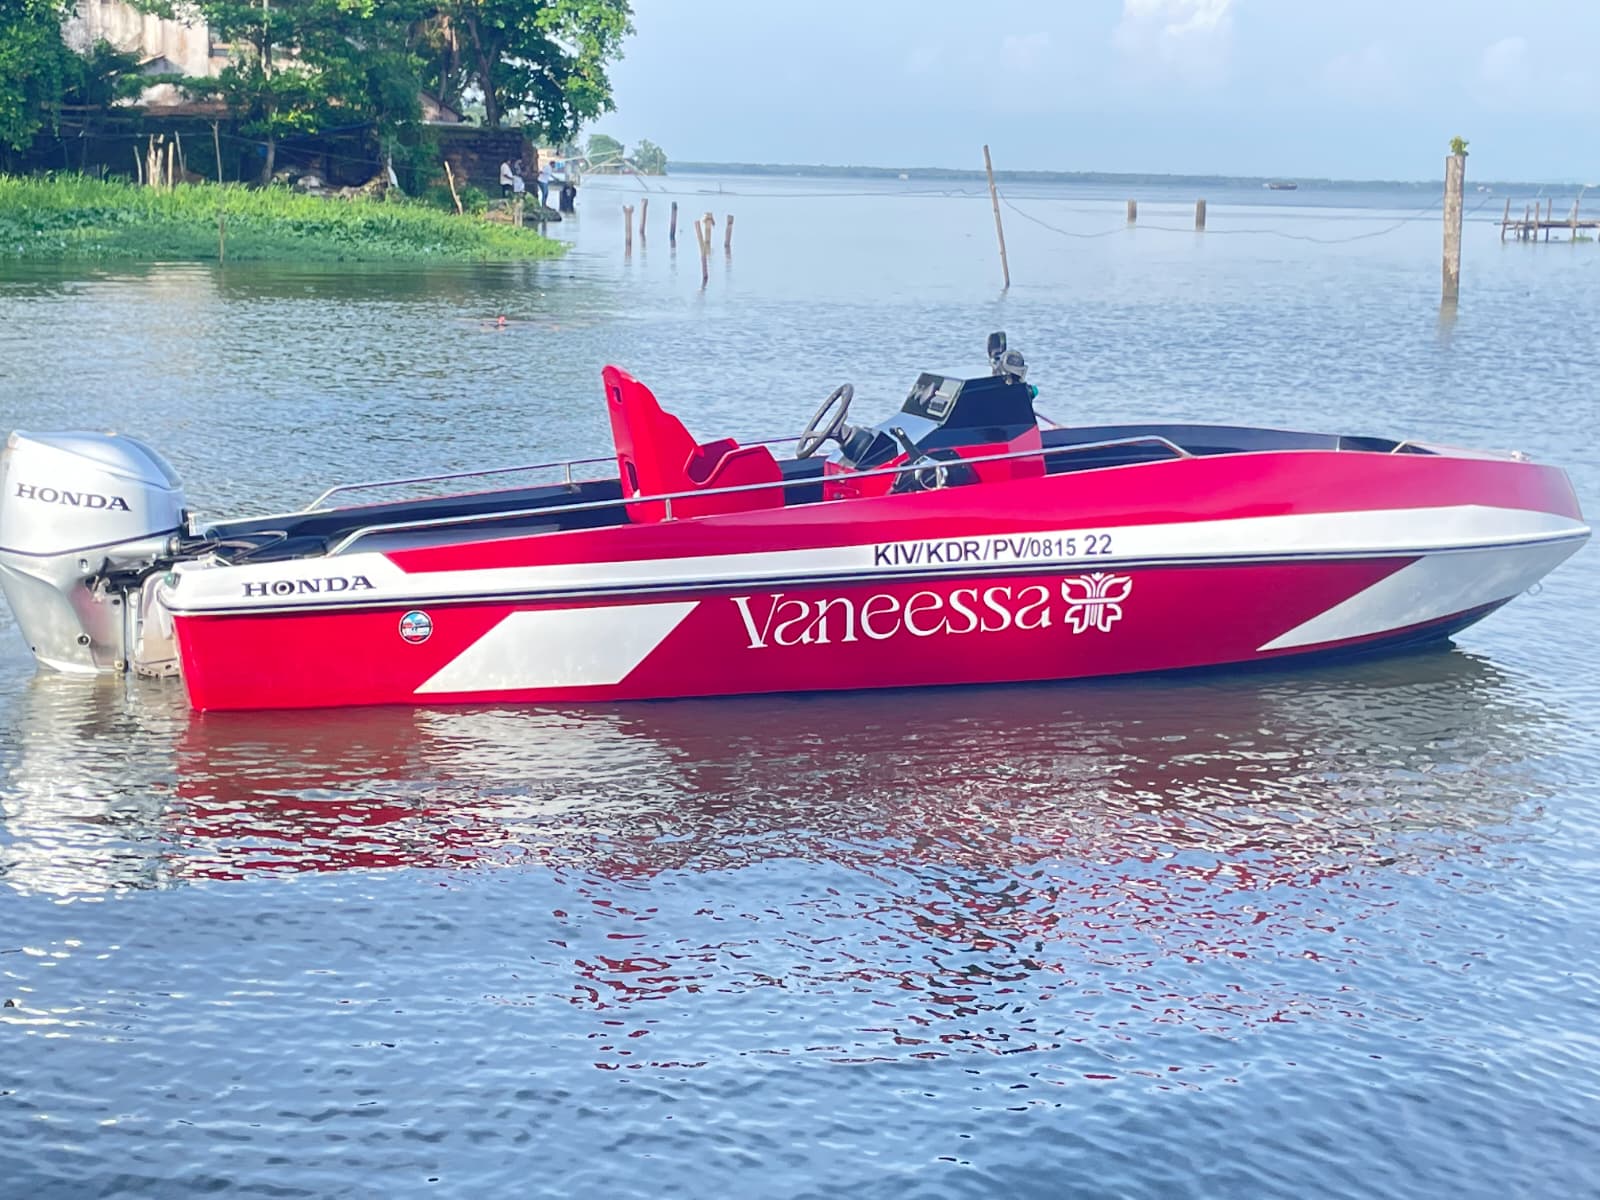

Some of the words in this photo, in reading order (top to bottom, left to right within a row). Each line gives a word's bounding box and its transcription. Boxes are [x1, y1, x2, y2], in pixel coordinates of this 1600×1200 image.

[15, 482, 131, 512] HONDA
[1084, 534, 1113, 556] 22
[242, 575, 376, 598] HONDA
[730, 585, 1052, 649] Vaneessa
